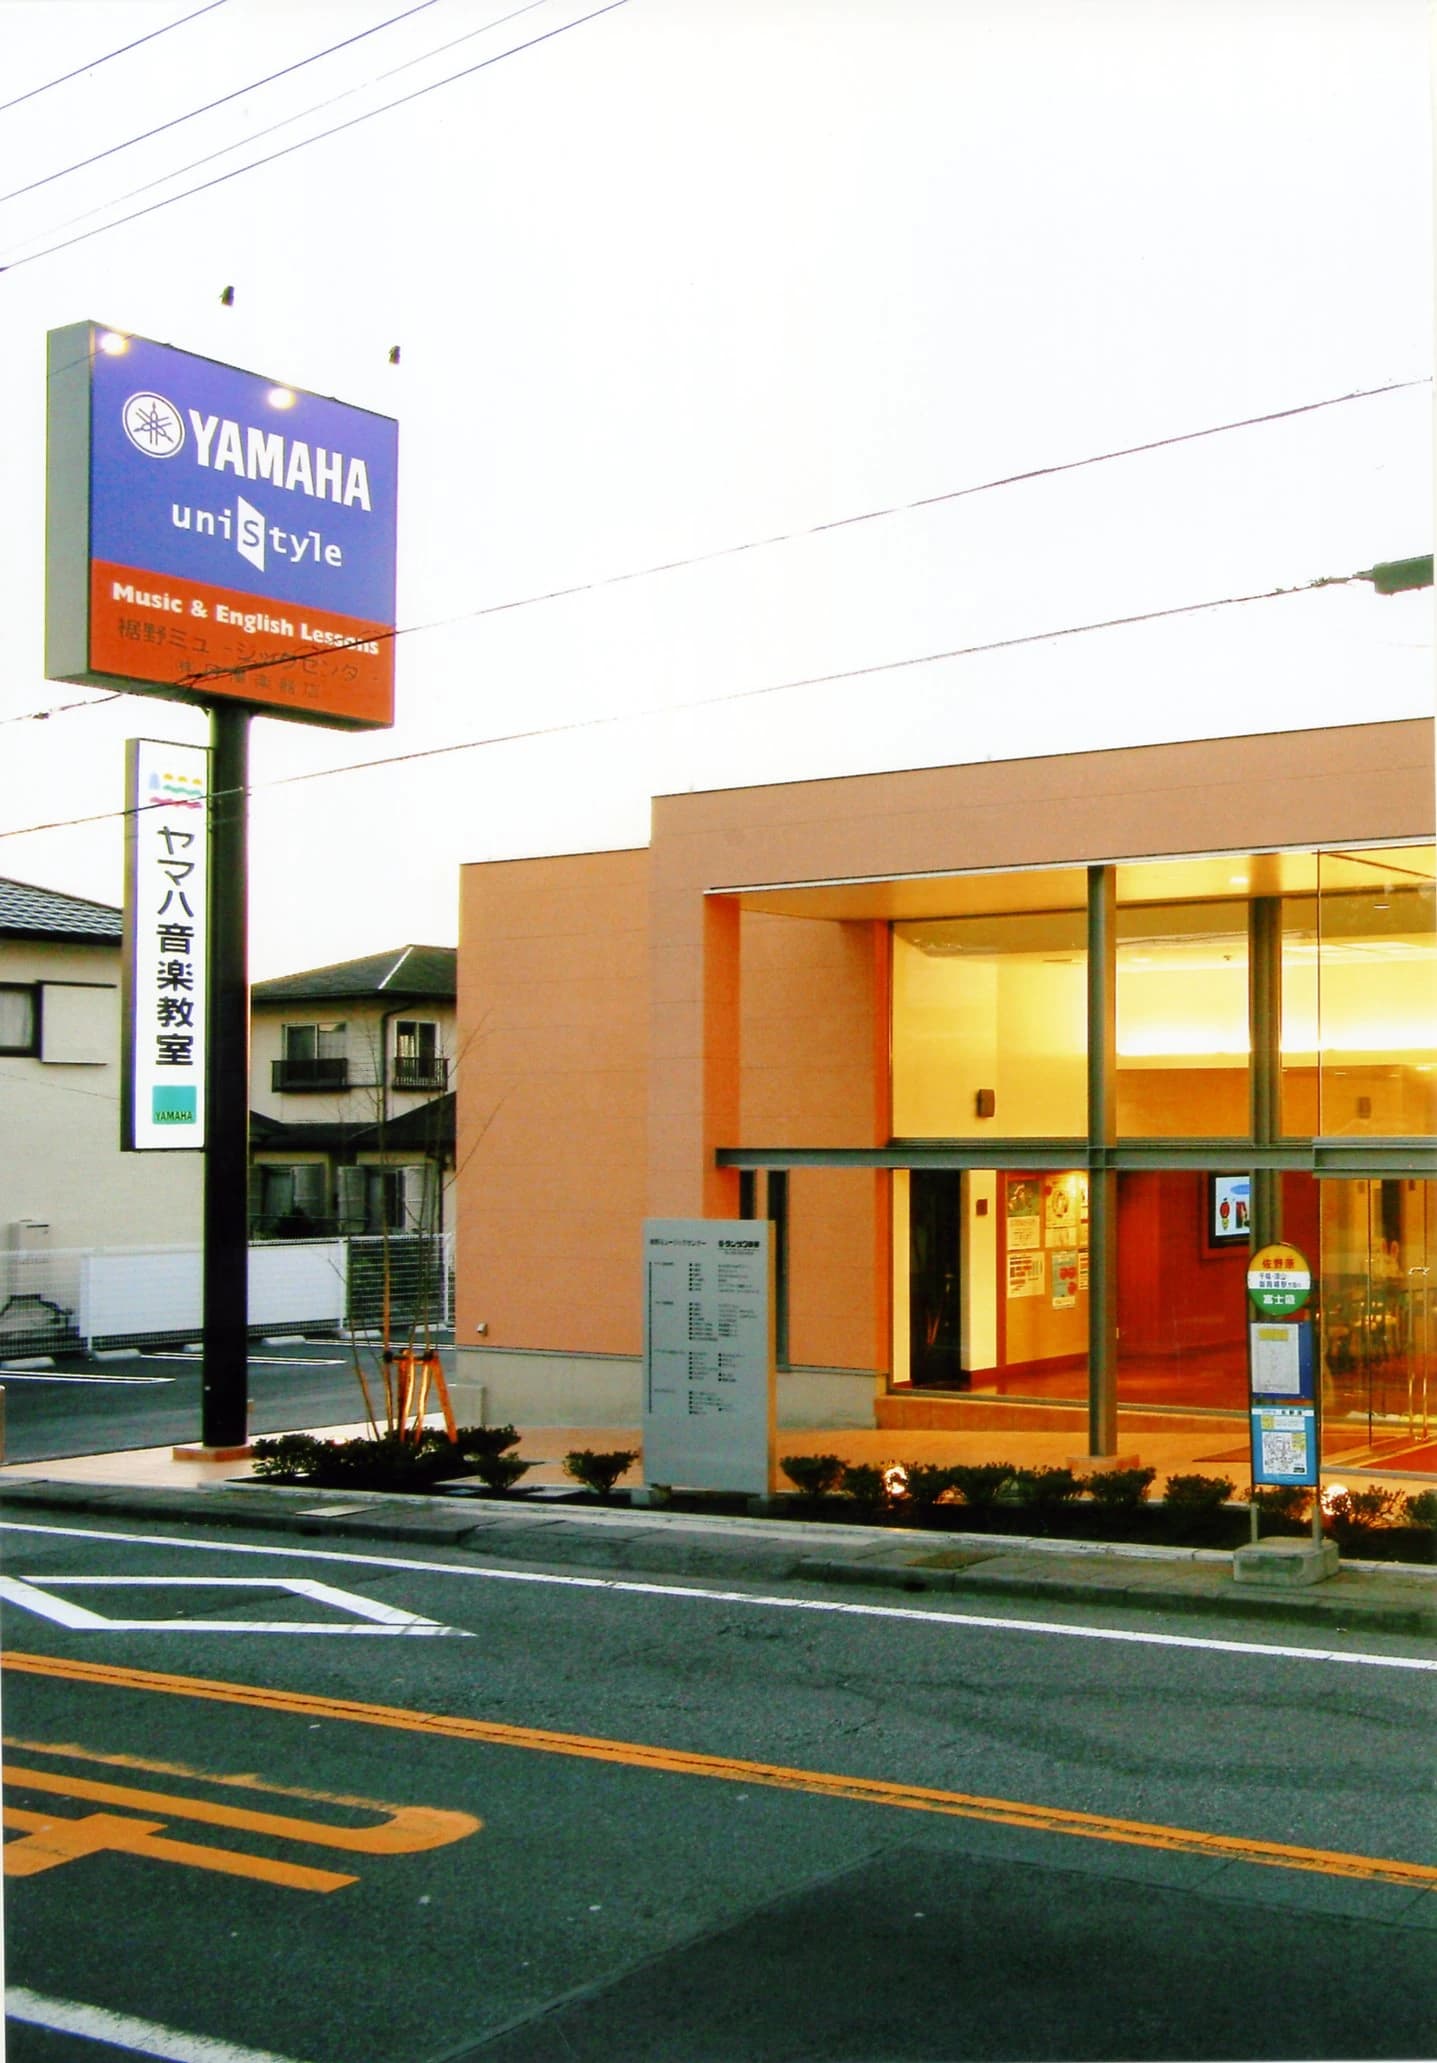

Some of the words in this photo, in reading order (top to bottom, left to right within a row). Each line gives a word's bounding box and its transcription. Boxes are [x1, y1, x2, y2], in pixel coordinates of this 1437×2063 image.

[190, 408, 372, 512] YAMAHA
[172, 497, 342, 572] uniStyle
[113, 581, 182, 614] Music
[190, 598, 208, 619] &
[216, 604, 294, 636] English
[301, 623, 379, 655] Lessons
[156, 826, 195, 1067] ヤマハ音楽教室
[153, 1110, 194, 1123] YAMAHA
